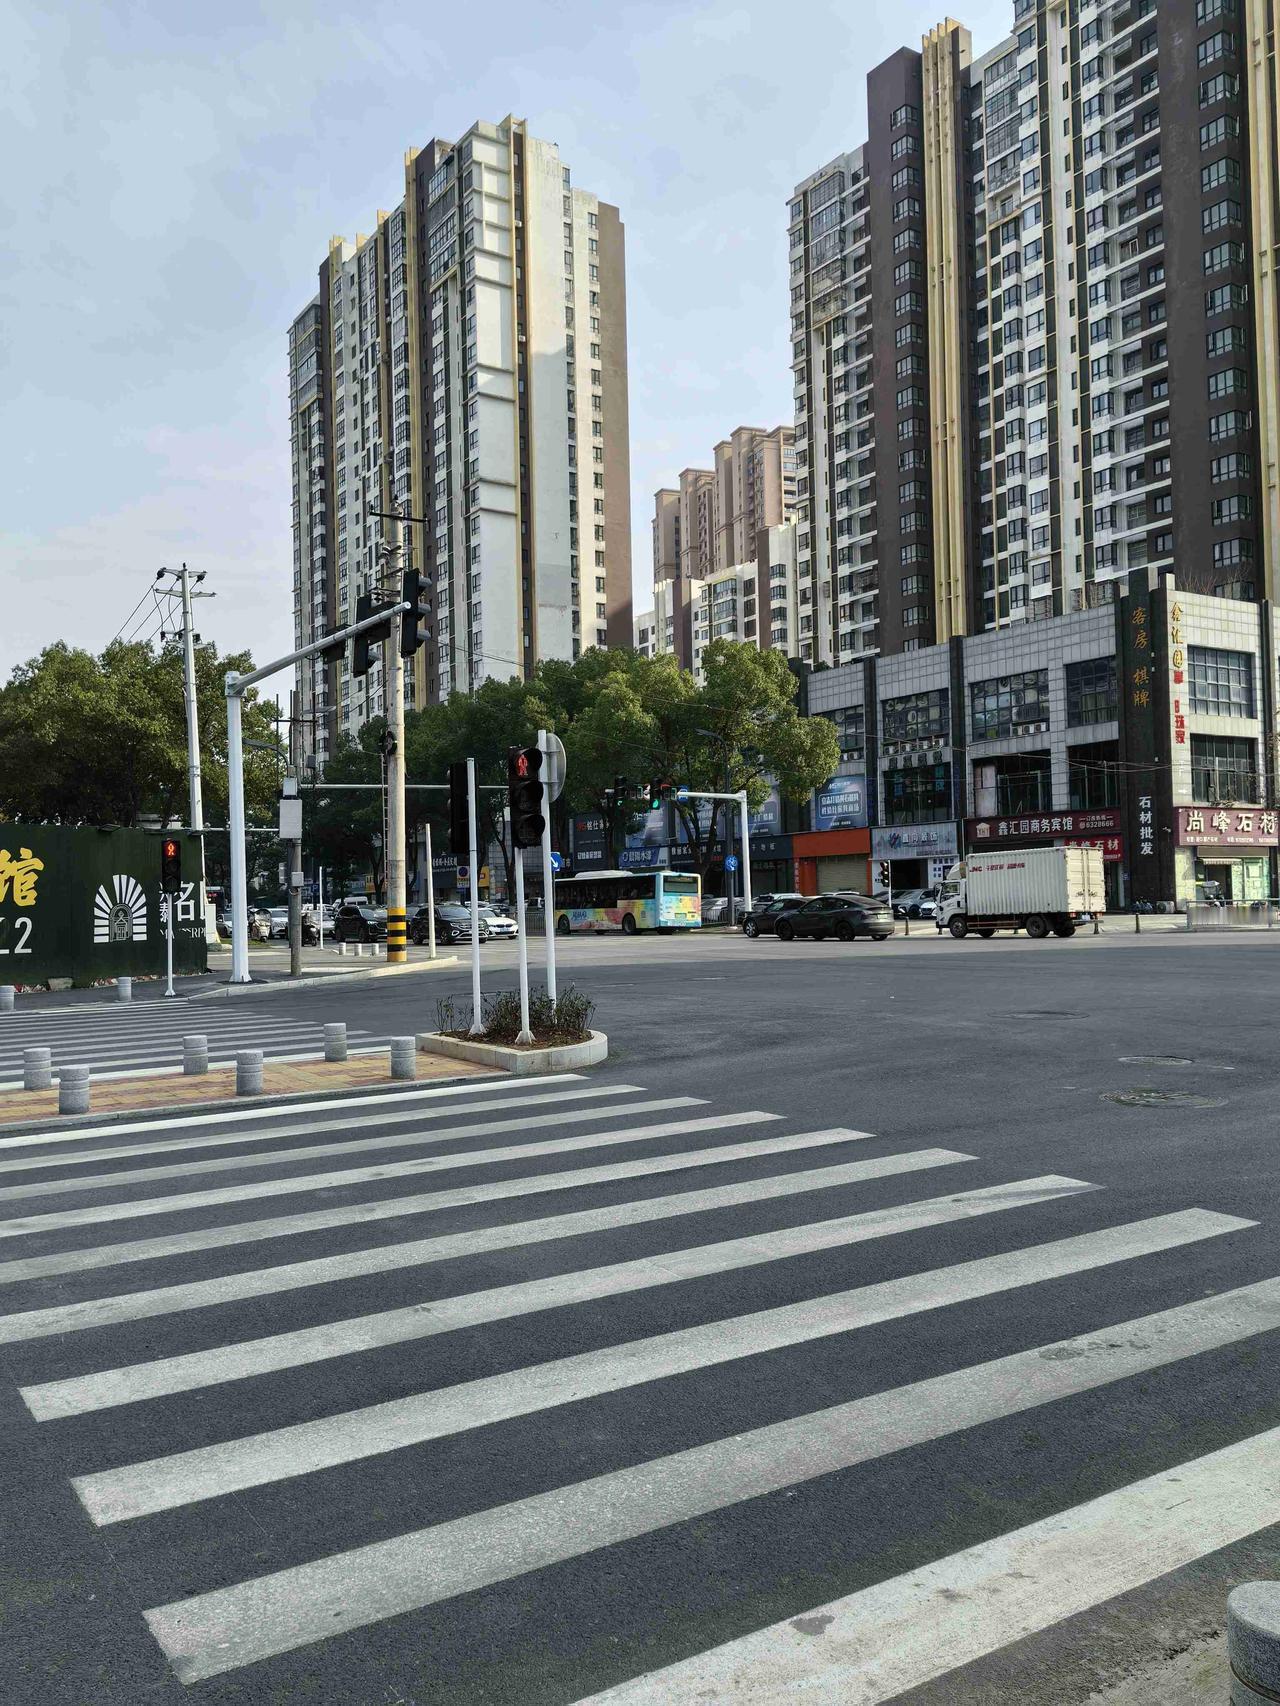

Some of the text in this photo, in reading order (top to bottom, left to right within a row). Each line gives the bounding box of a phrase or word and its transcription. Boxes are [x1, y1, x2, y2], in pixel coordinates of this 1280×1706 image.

[1131, 606, 1150, 708] 客房 棋牌
[998, 817, 1073, 836] 鑫汇园商务宾馆
[1139, 796, 1154, 855] 石材批发
[1186, 810, 1278, 834] 尚峰石材
